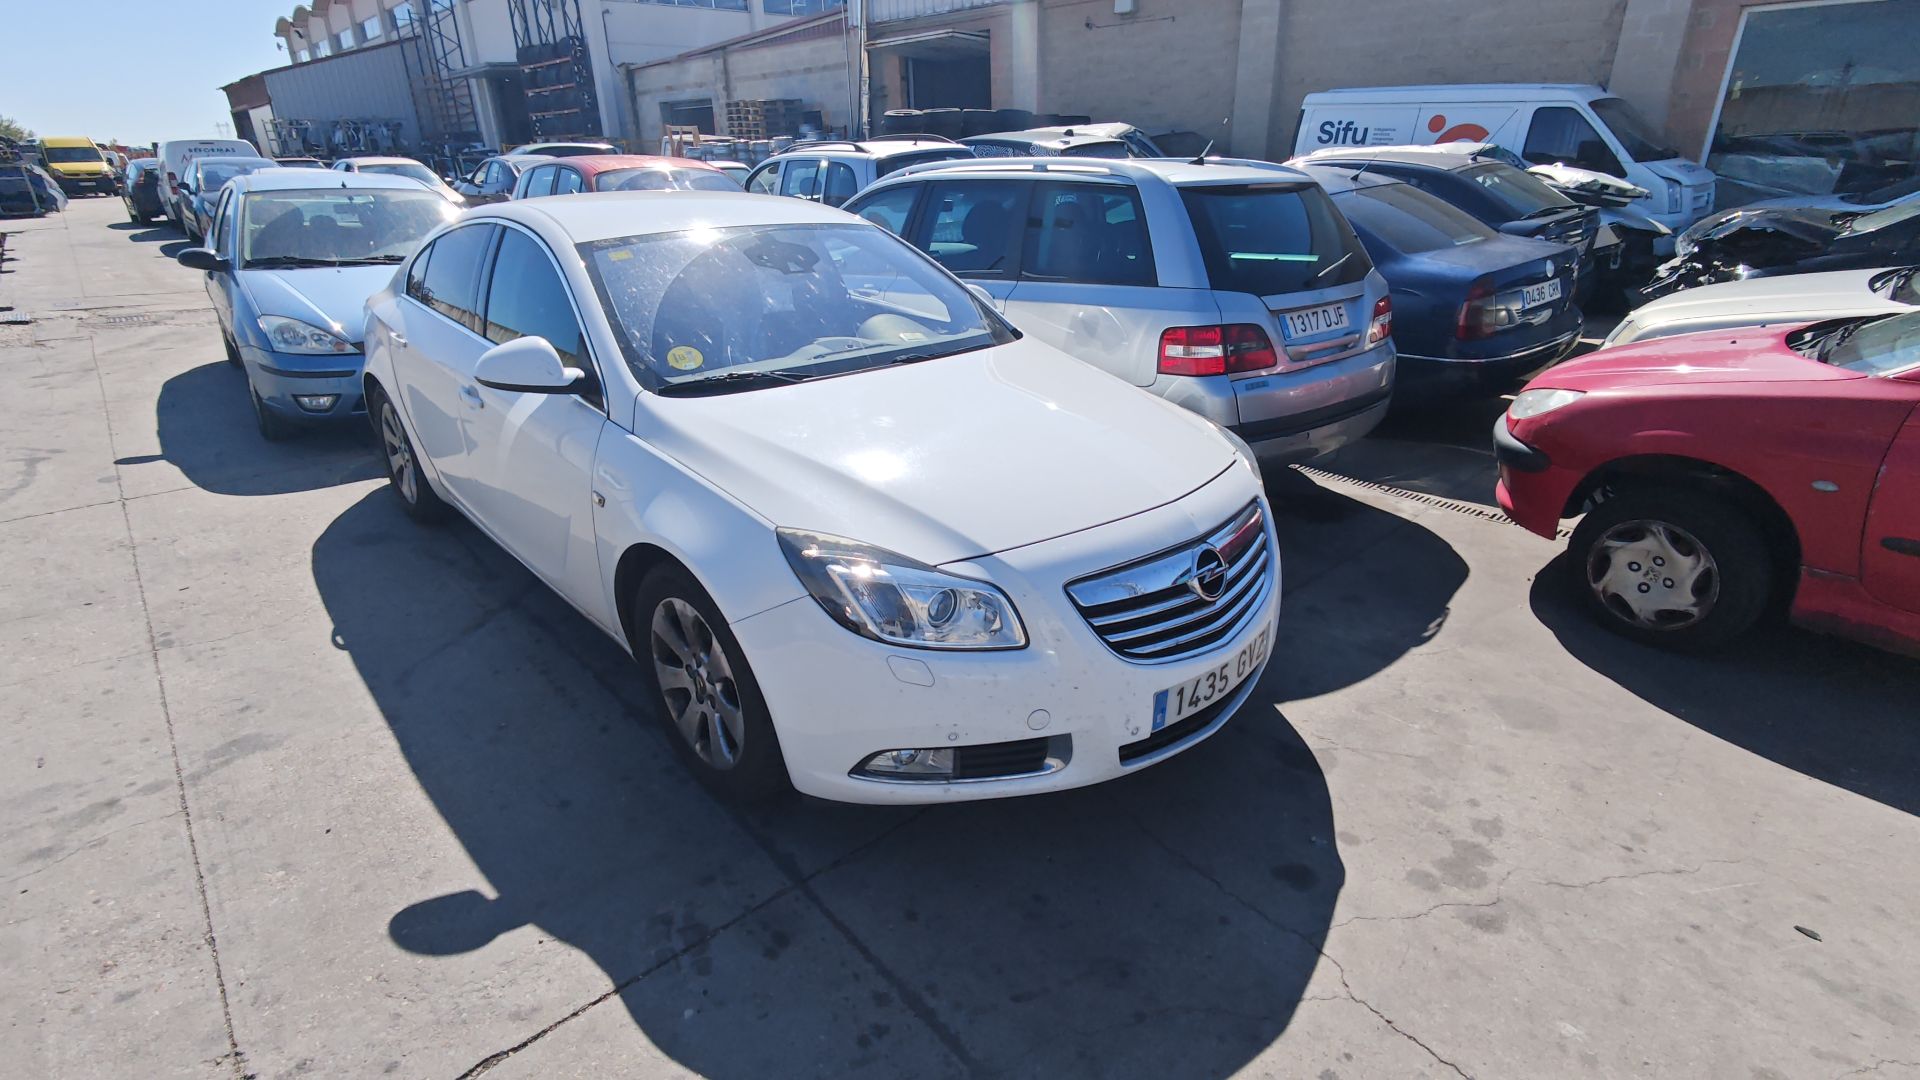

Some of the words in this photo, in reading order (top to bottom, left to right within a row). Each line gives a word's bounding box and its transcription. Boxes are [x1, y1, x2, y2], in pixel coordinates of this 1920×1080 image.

[1317, 120, 1369, 145] Sifu
[1525, 286, 1545, 306] 0436
[1290, 311, 1319, 335] 1317
[1322, 306, 1344, 328] DJF
[1177, 663, 1229, 716] 1435
[1238, 632, 1267, 677] GVZ
